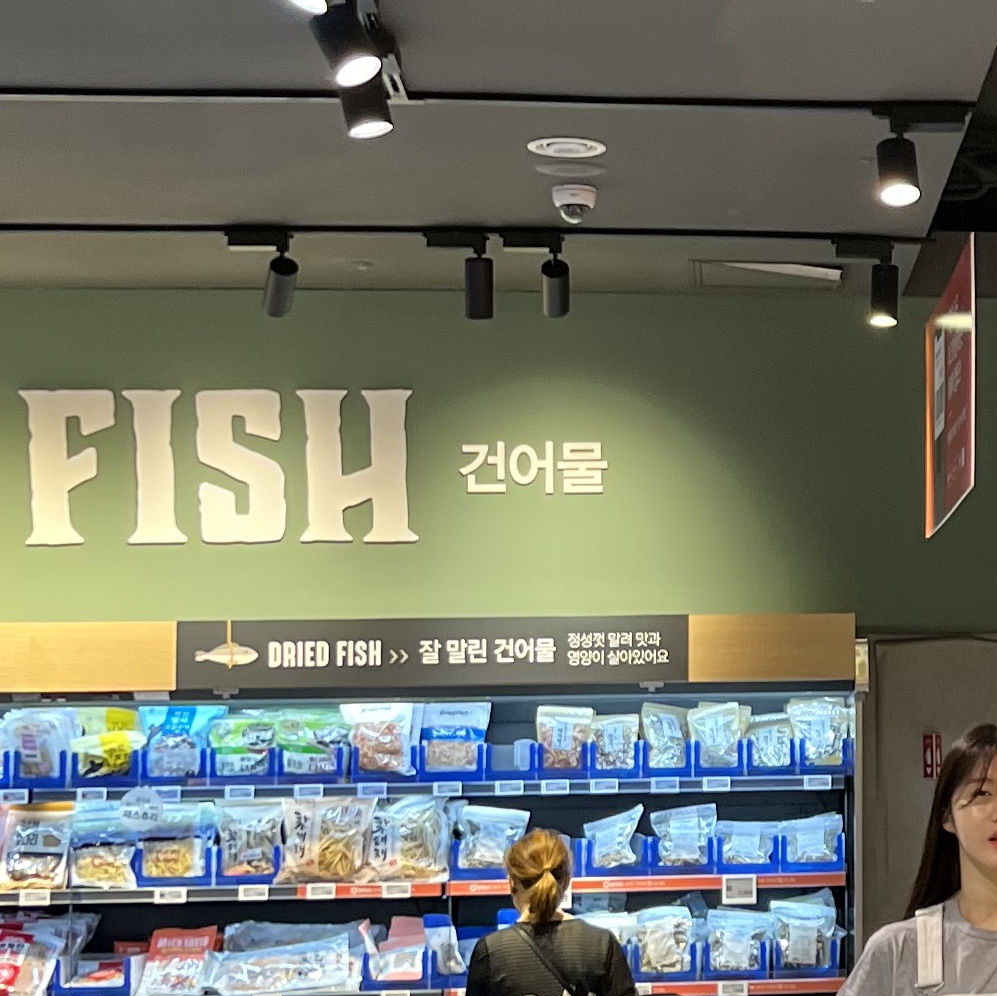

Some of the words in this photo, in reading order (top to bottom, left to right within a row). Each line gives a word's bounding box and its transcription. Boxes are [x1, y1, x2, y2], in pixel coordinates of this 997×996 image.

[18, 388, 420, 546] FISH
[458, 441, 609, 496] 건어물
[267, 640, 330, 668] DRIED
[335, 639, 382, 667] FISH
[418, 637, 443, 665] 잘
[446, 637, 488, 664] 말린
[493, 636, 557, 664] 건어물
[567, 631, 605, 649] 정성껏
[607, 631, 633, 648] 말려
[635, 631, 662, 648] 맛과
[566, 649, 605, 666] 영양이
[607, 648, 670, 666] 살아있어요
